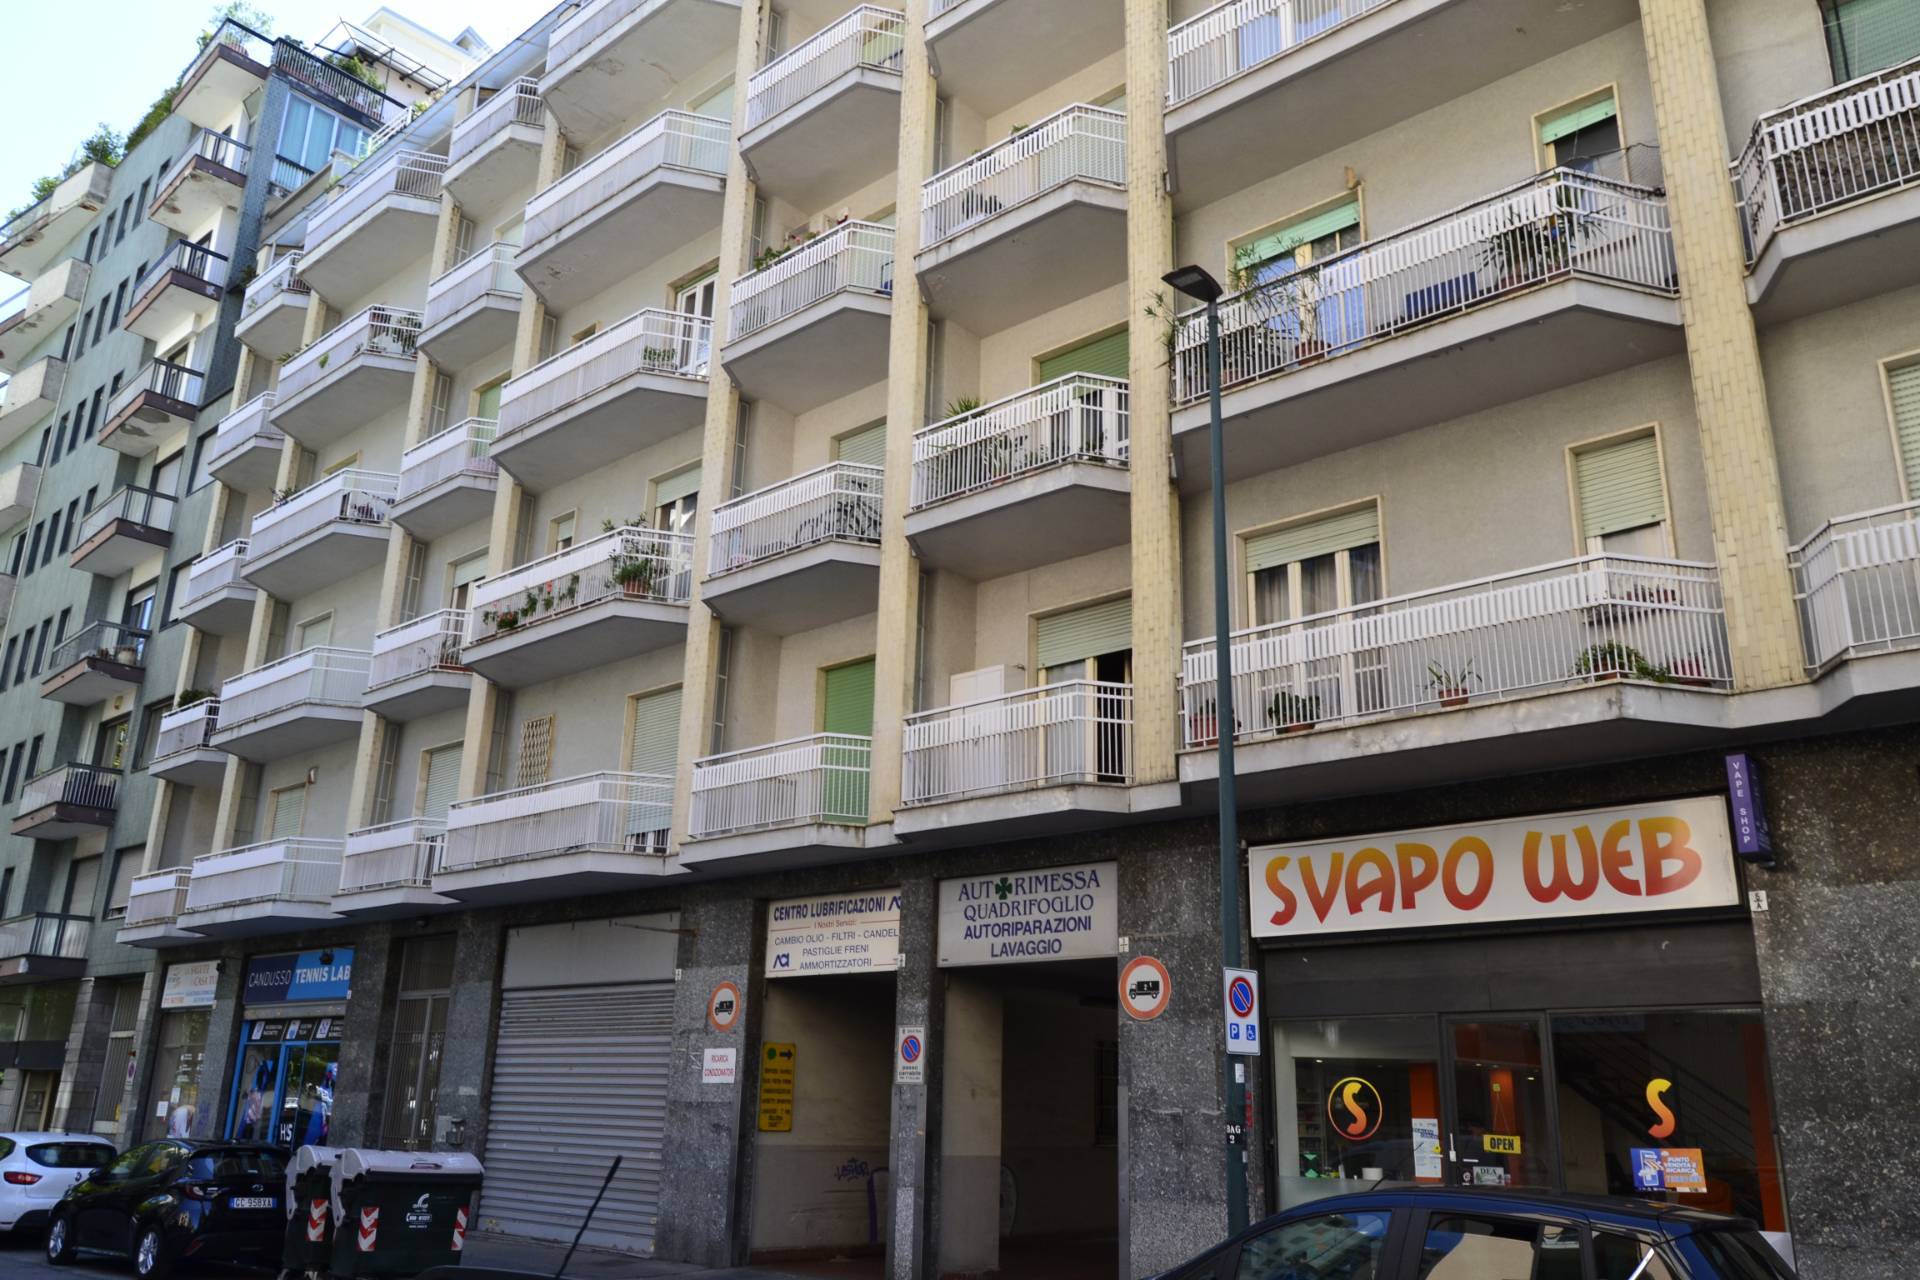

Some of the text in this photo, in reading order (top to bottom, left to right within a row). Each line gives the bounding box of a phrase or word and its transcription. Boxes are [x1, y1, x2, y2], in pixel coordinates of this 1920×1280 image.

[1733, 762, 1744, 797] VAPE
[1739, 808, 1750, 844] SHOP
[1265, 816, 1702, 926] SVAPO WEB
[774, 904, 808, 921] CENTRO
[811, 896, 886, 918] LUBRIFICAZIONI
[964, 894, 1094, 921] QUADRIFOGLIO
[818, 921, 834, 929] Nostri
[964, 916, 1091, 940] AUTORIPARAZIONI
[775, 935, 803, 945] CAMBIO
[806, 934, 824, 943] OLIO
[832, 931, 855, 941] FILTRI
[802, 944, 869, 956] PASTIGLIE FRENI
[991, 939, 1062, 958] LAVAGGIO
[249, 965, 351, 987] CANDUSSO TENNIS LAB
[800, 958, 871, 970] AMMORTIZZATORI
[1343, 1082, 1367, 1134] S
[1646, 1078, 1675, 1138] S
[1490, 1137, 1514, 1151] OPEN
